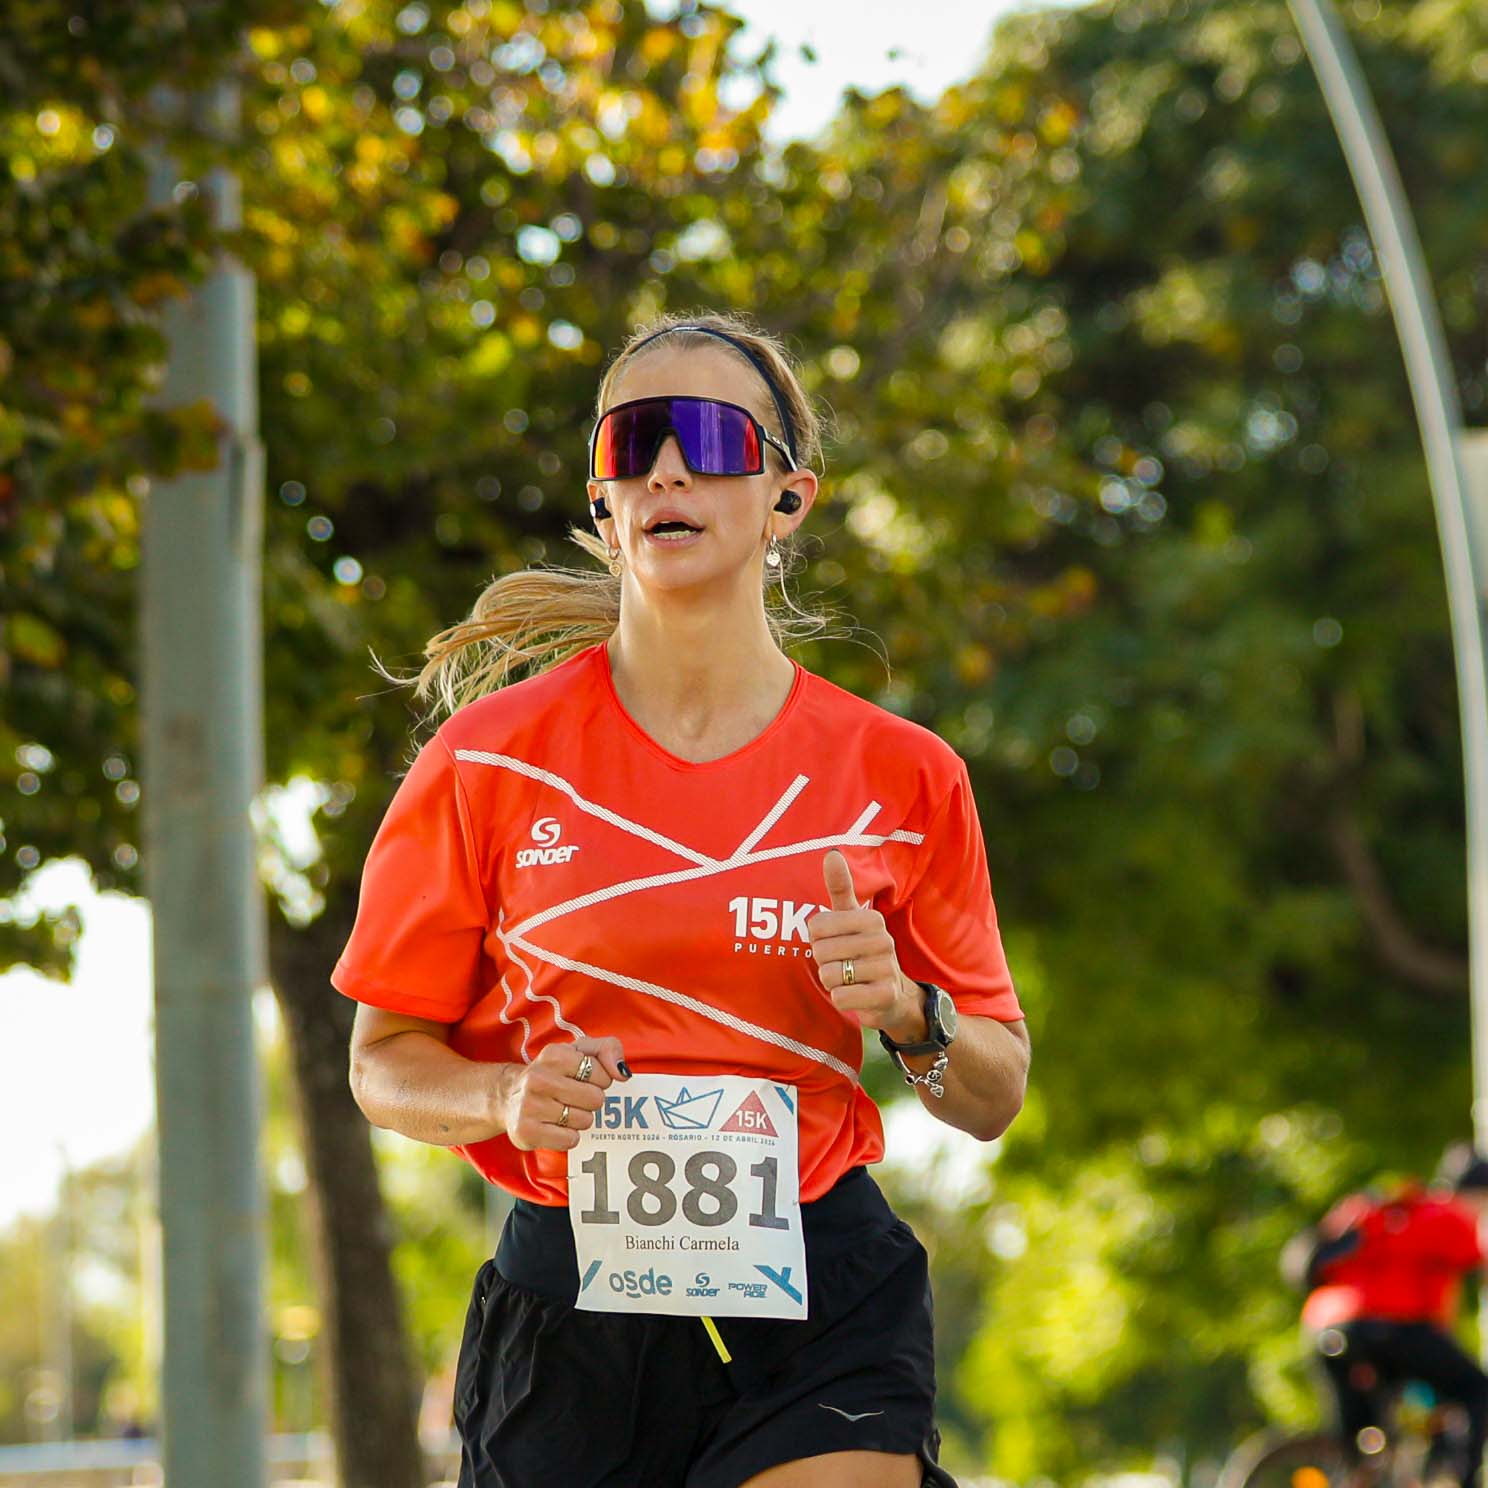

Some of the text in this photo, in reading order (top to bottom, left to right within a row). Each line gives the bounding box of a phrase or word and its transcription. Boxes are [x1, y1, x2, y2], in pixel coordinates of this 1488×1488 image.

[728, 896, 816, 943] 15K
[734, 942, 813, 958] PUERTO
[735, 1110, 768, 1130] 15K
[591, 1133, 616, 1141] PUERTO
[617, 1133, 640, 1141] NORTE
[581, 1150, 790, 1231] 1881
[625, 1235, 740, 1251] Bianchi Carmela
[609, 1267, 673, 1298] osde
[728, 1283, 768, 1291] POWER
